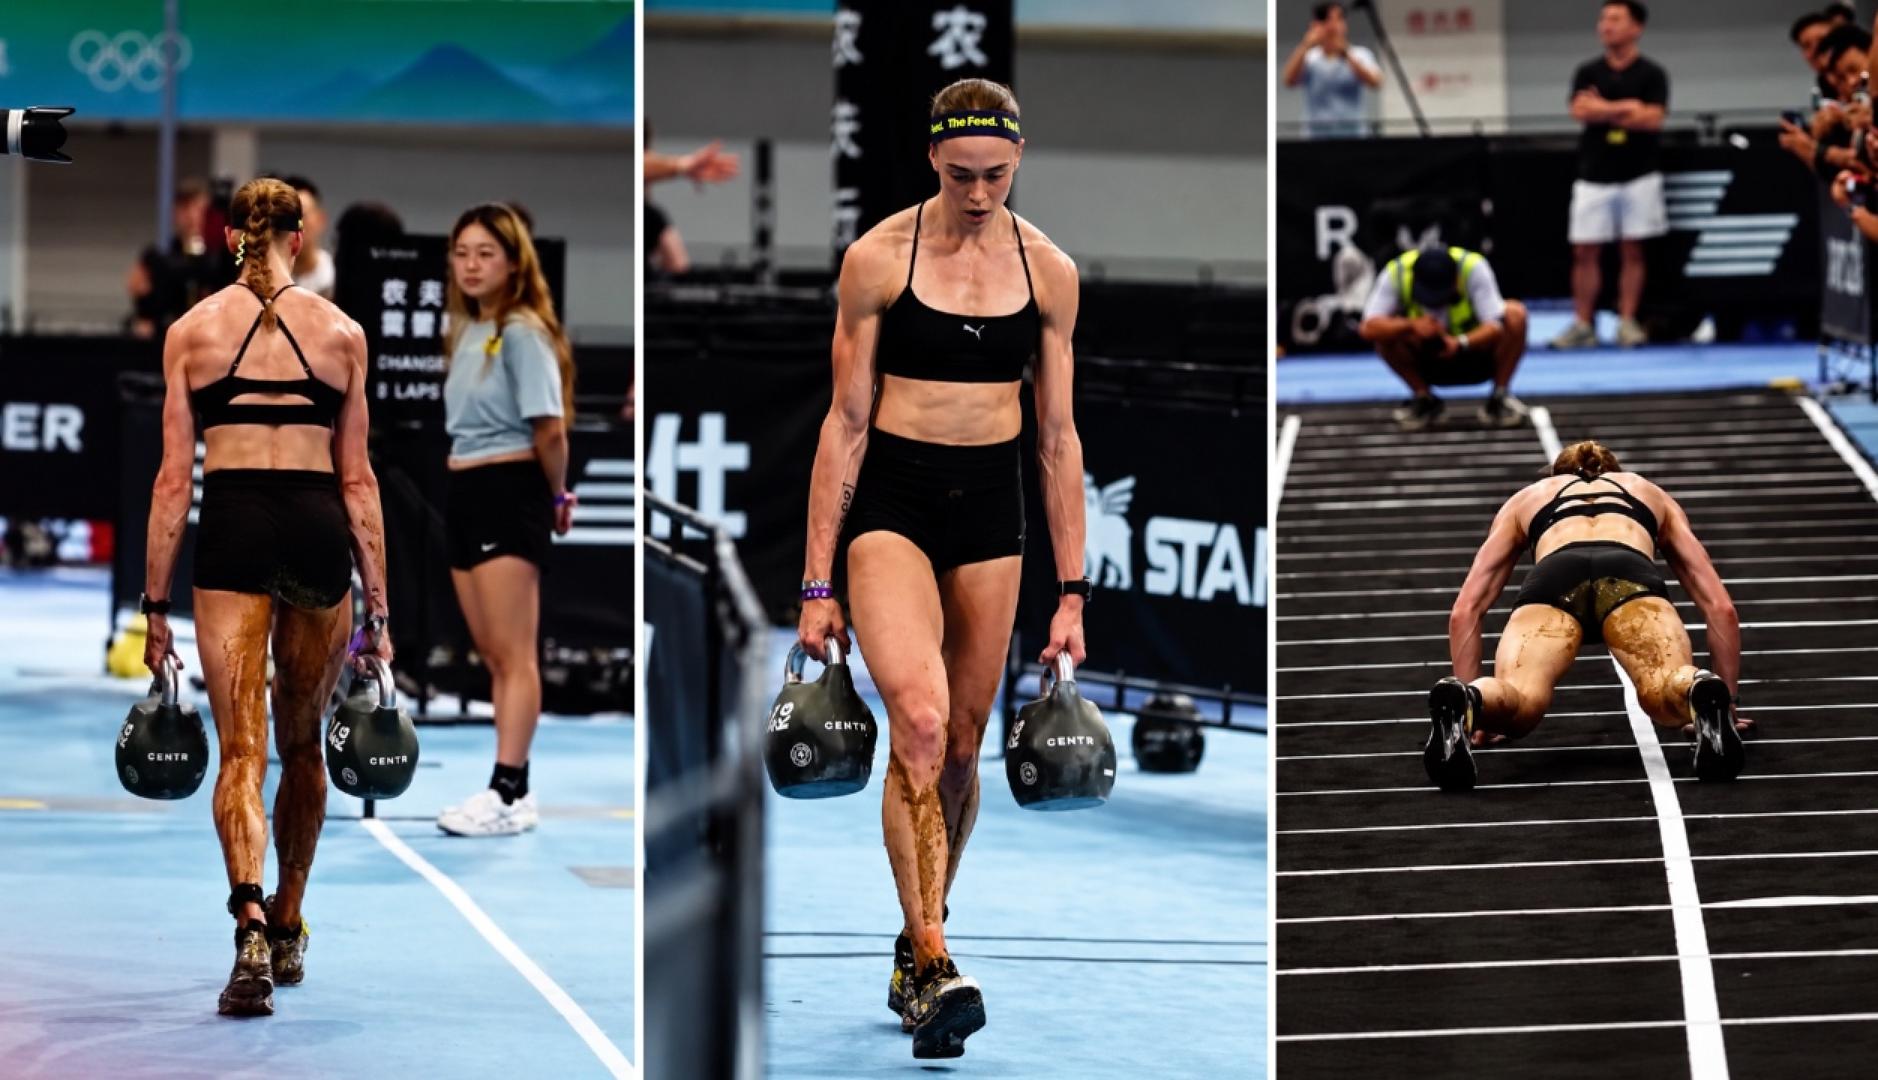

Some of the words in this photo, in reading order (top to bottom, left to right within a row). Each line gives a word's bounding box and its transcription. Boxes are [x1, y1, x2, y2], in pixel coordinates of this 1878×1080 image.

[928, 6, 989, 69] 农
[948, 117, 966, 128] The
[967, 115, 998, 126] Feed.
[394, 382, 440, 400] LAPS
[0, 402, 84, 451] ER
[824, 720, 867, 732] CENTR
[1046, 735, 1094, 747] CENTR
[147, 752, 188, 761] CENTR
[369, 755, 408, 766] CENTR
